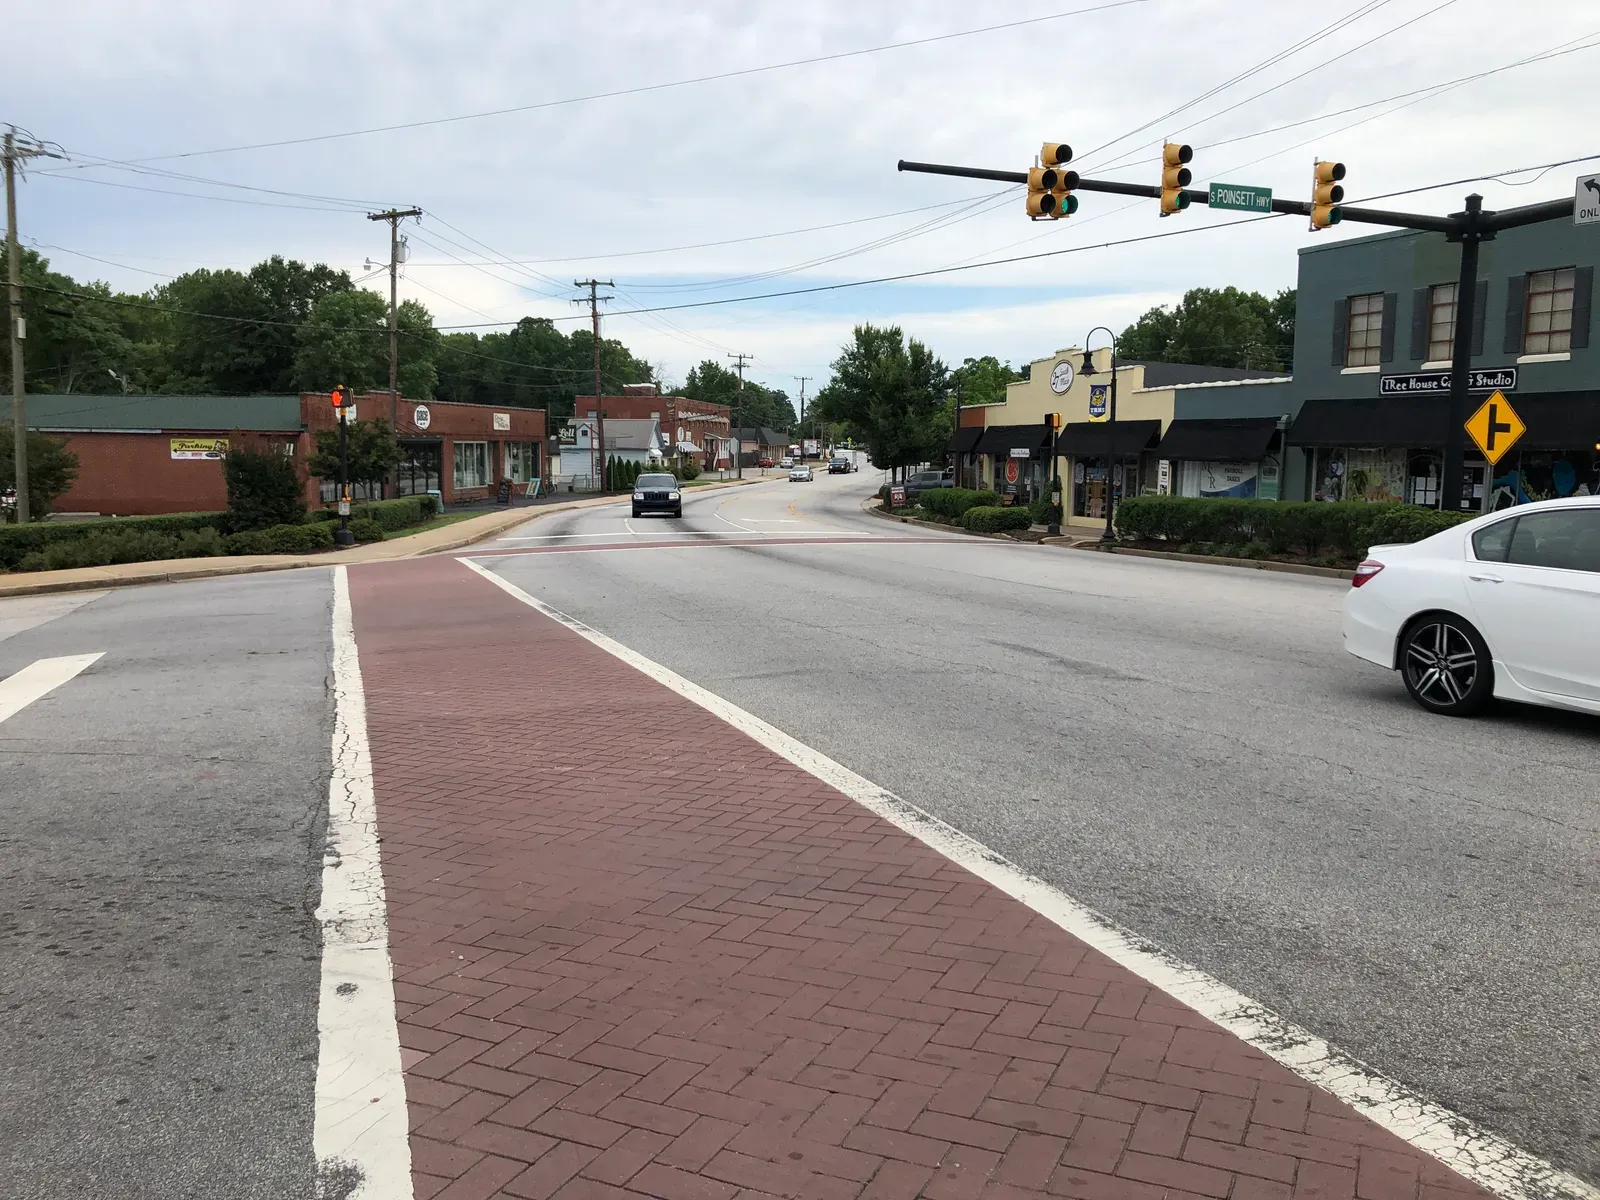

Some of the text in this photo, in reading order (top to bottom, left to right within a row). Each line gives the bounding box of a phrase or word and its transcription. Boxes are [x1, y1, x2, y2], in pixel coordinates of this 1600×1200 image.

[1210, 189, 1271, 207] S POINSETT HWY
[1580, 207, 1600, 219] ONL
[1409, 377, 1439, 389] House
[1476, 372, 1512, 387] Studio
[1226, 475, 1241, 483] TAXES
